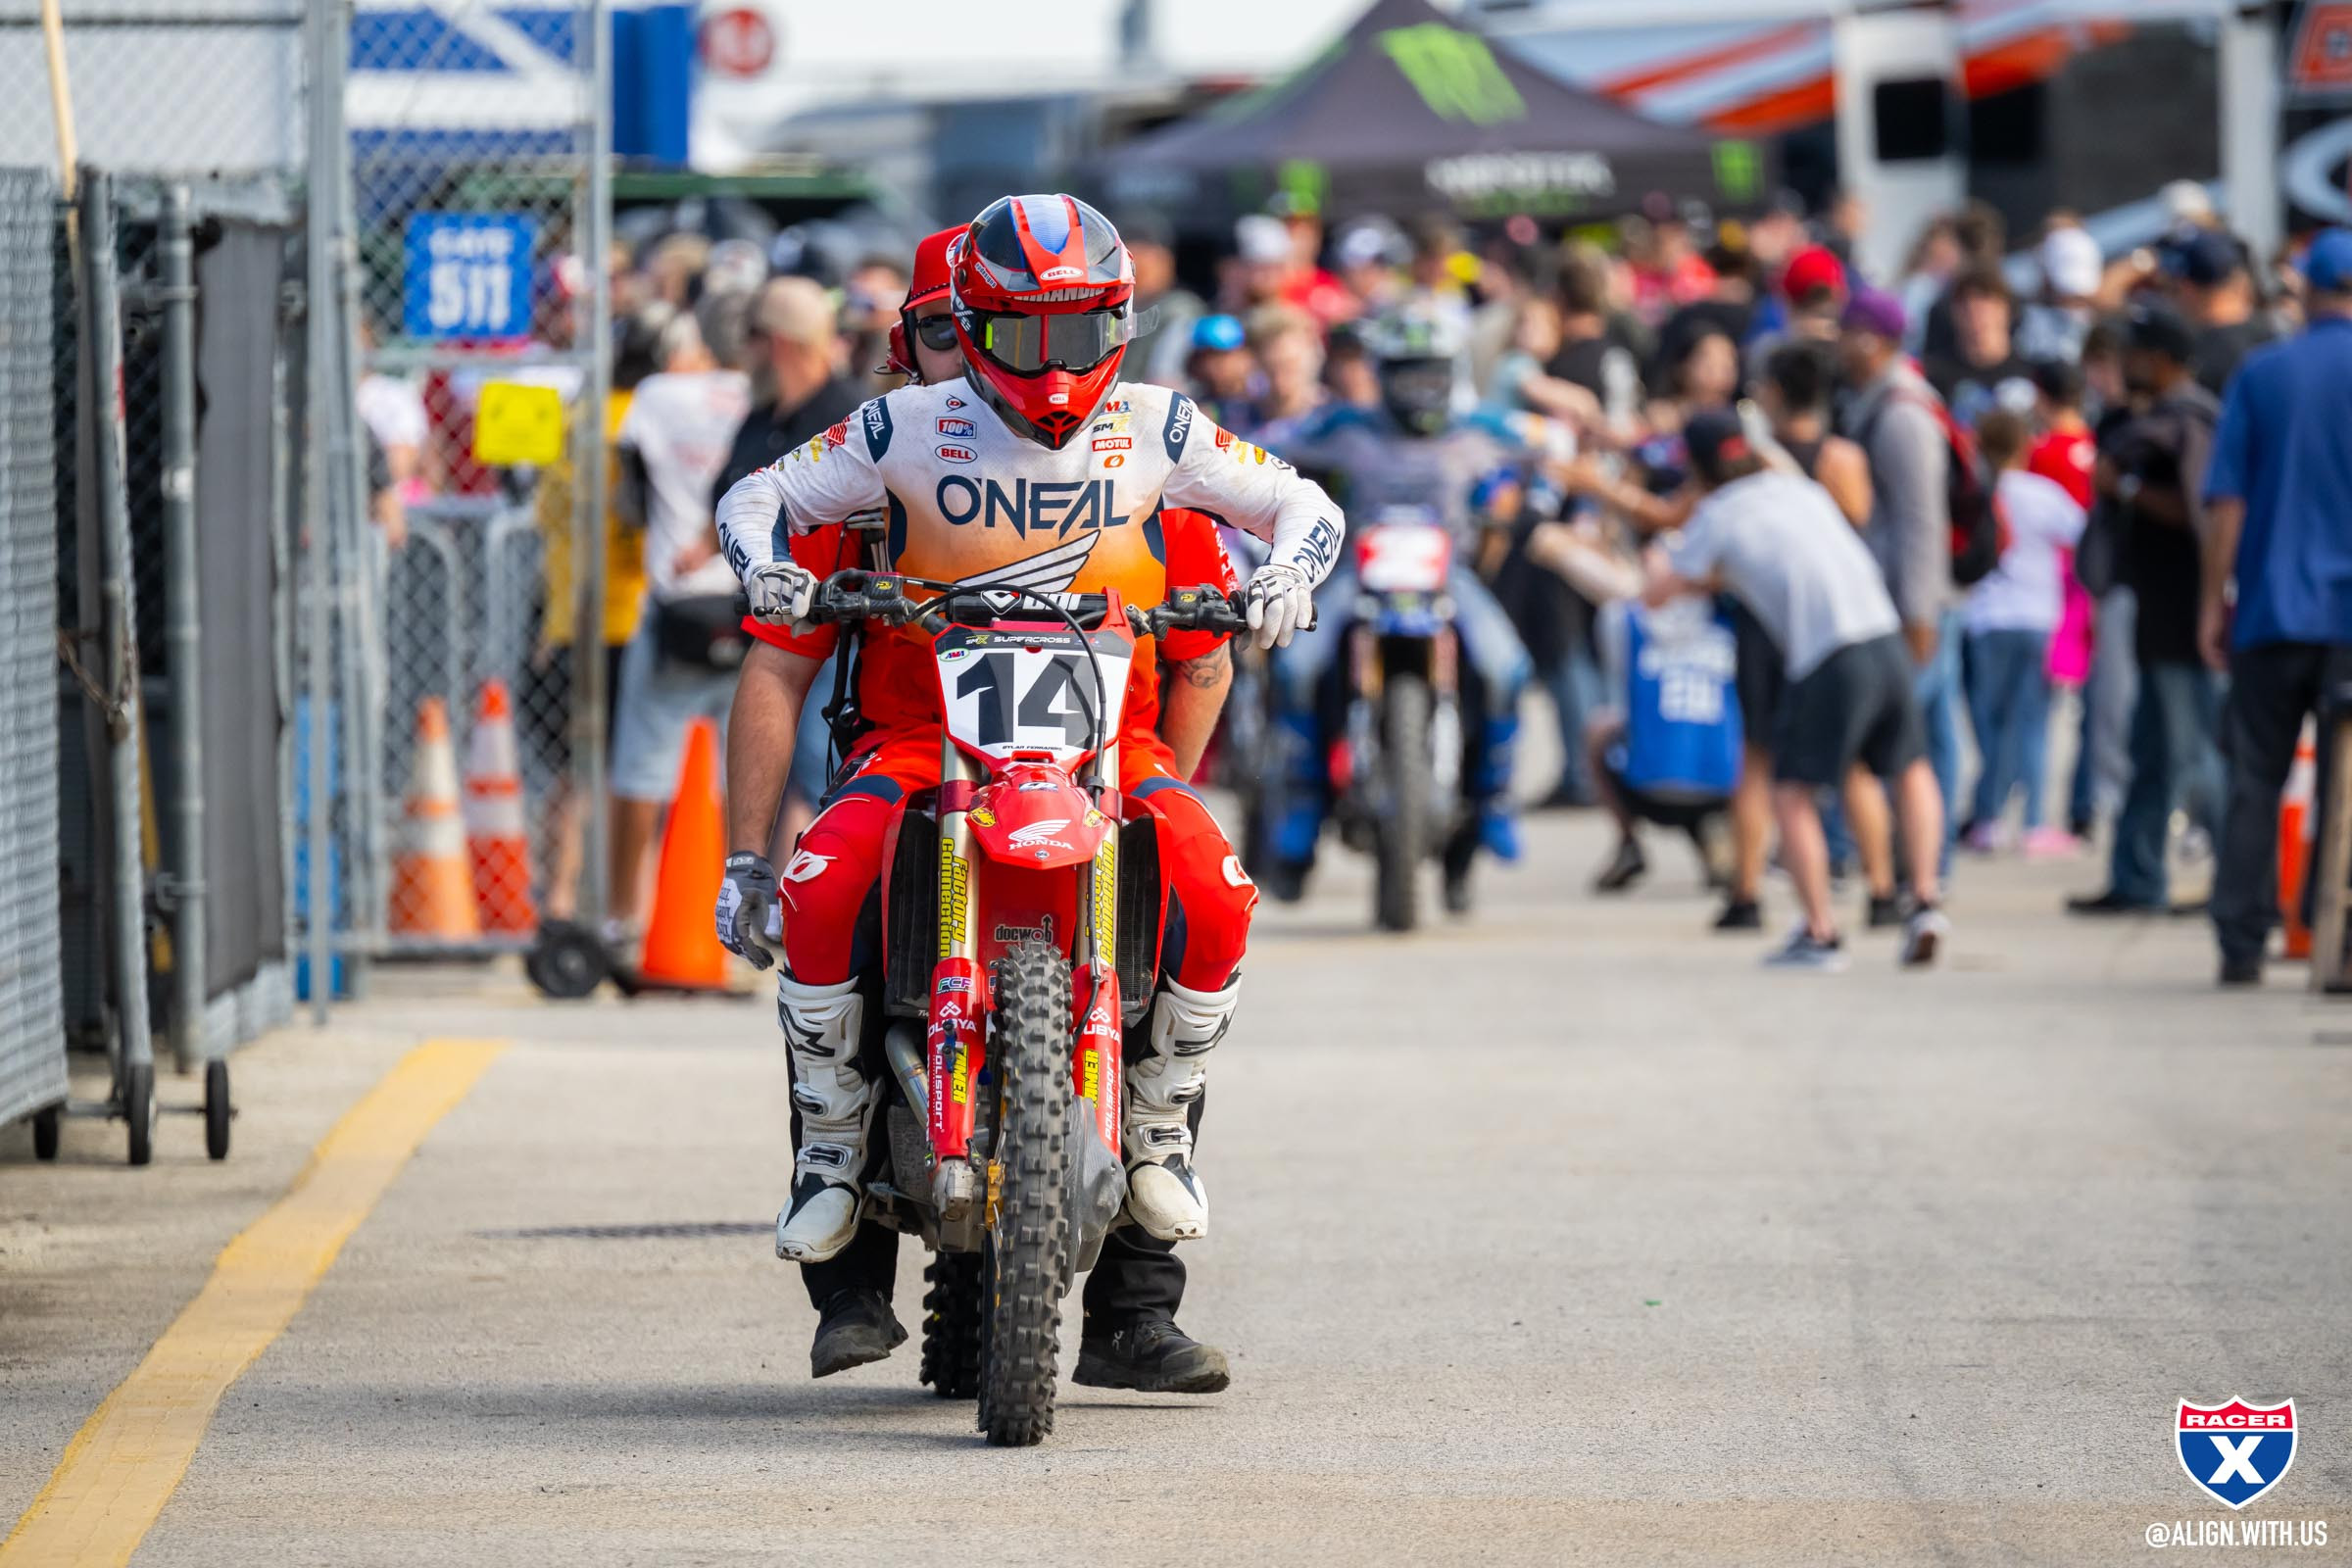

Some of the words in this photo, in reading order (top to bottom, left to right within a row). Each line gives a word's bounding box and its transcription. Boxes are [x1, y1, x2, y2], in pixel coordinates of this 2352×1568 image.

[428, 263, 512, 329] 511
[1100, 400, 1131, 414] MA
[942, 420, 973, 436] 100%
[1094, 438, 1130, 450] MOTUL
[941, 447, 972, 461] BELL
[945, 649, 965, 660] AMA
[956, 652, 1098, 751] 14
[1007, 839, 1075, 851] HONDA
[953, 856, 969, 944] Factory
[1074, 1023, 1122, 1044] UBYA
[1104, 1054, 1114, 1142] POLISPORT
